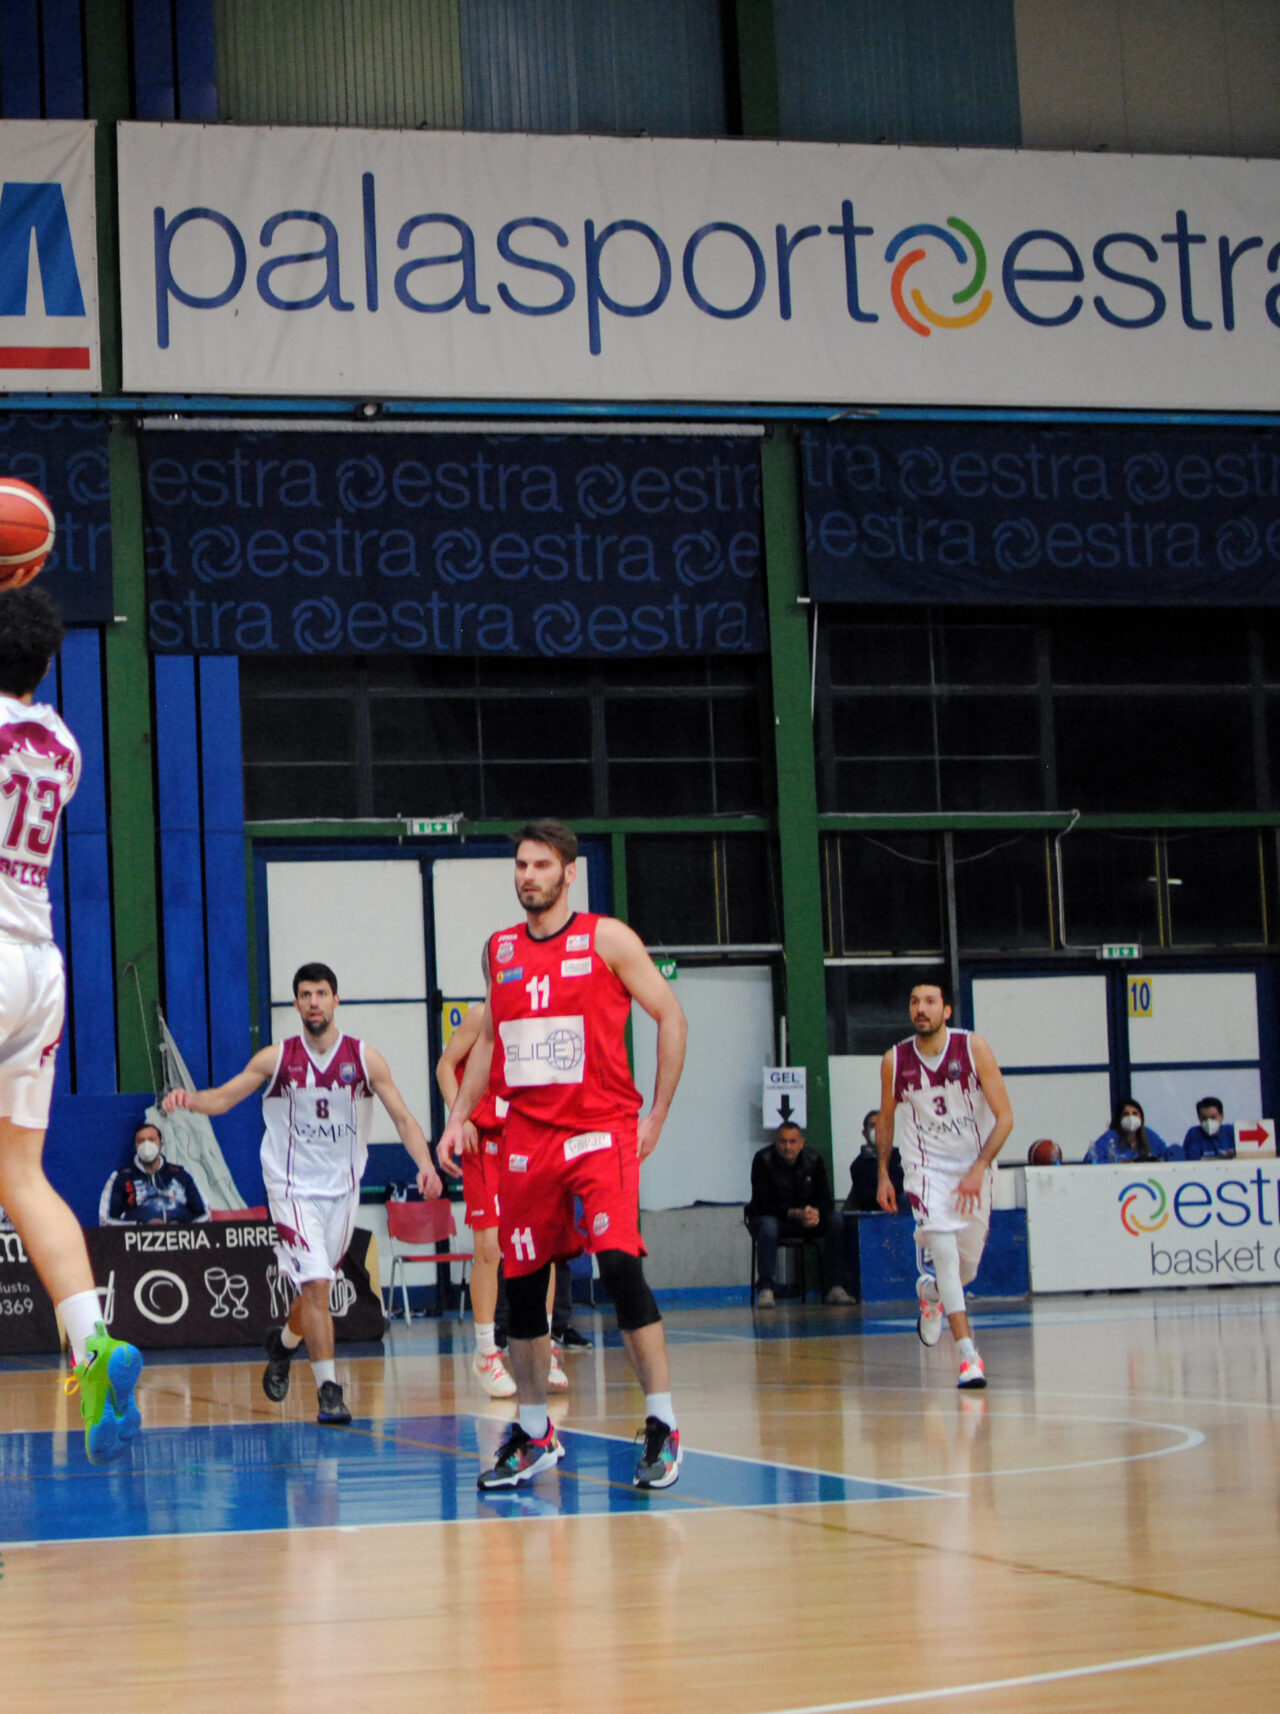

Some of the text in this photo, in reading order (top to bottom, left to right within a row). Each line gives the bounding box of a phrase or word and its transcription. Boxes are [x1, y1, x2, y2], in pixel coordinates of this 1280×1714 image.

[152, 172, 879, 355] palasport
[146, 448, 325, 508] estra
[392, 451, 564, 513] estra
[630, 454, 761, 513] estr
[950, 442, 1114, 500] estra
[247, 517, 421, 578] estra
[489, 522, 660, 582] estra
[820, 506, 981, 566] estra
[1046, 511, 1205, 569] estra
[347, 590, 520, 651] estra
[588, 593, 753, 652] estra
[525, 973, 550, 1011] 11
[1130, 981, 1151, 1012] 10
[770, 1072, 800, 1083] GEL
[932, 1095, 948, 1116] 3
[316, 1098, 330, 1119] 8
[1173, 1167, 1280, 1229] est
[124, 1226, 280, 1252] PIZZERIA BIRRE
[511, 1226, 537, 1262] 11
[1150, 1239, 1266, 1276] basket
